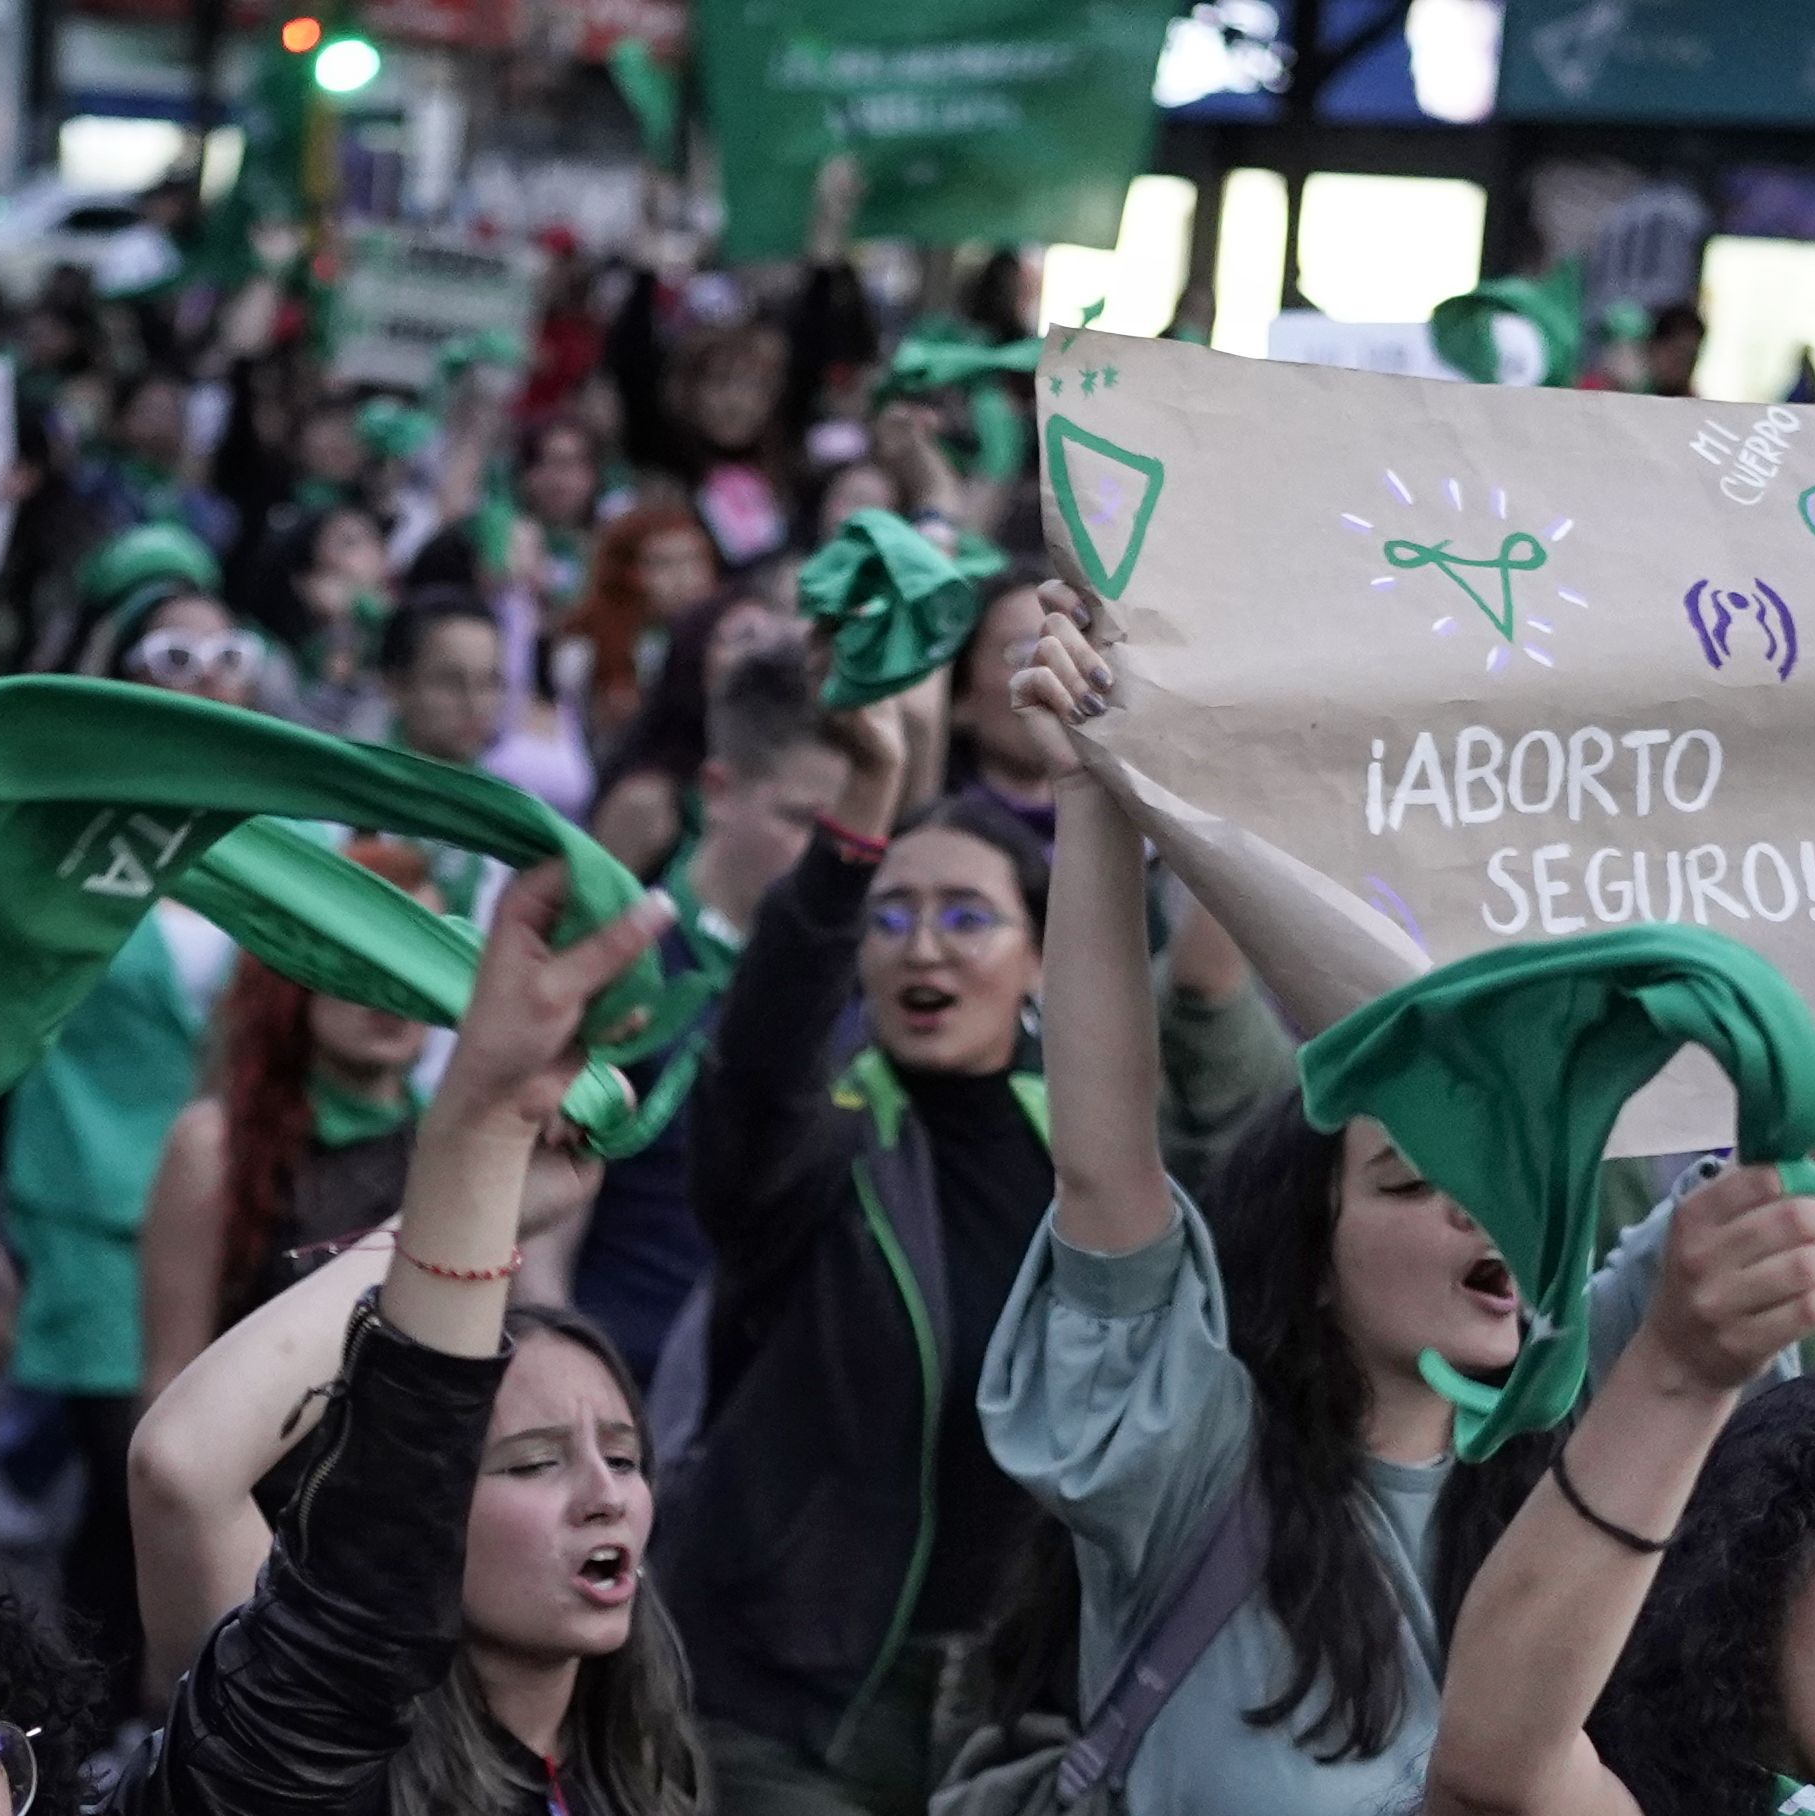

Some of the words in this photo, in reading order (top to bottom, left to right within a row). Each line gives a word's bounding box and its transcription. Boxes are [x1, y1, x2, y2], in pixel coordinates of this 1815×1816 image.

[1689, 419, 1741, 465] MI
[1719, 405, 1802, 506] CUERPO
[1366, 724, 1724, 836] ¡ABORTO
